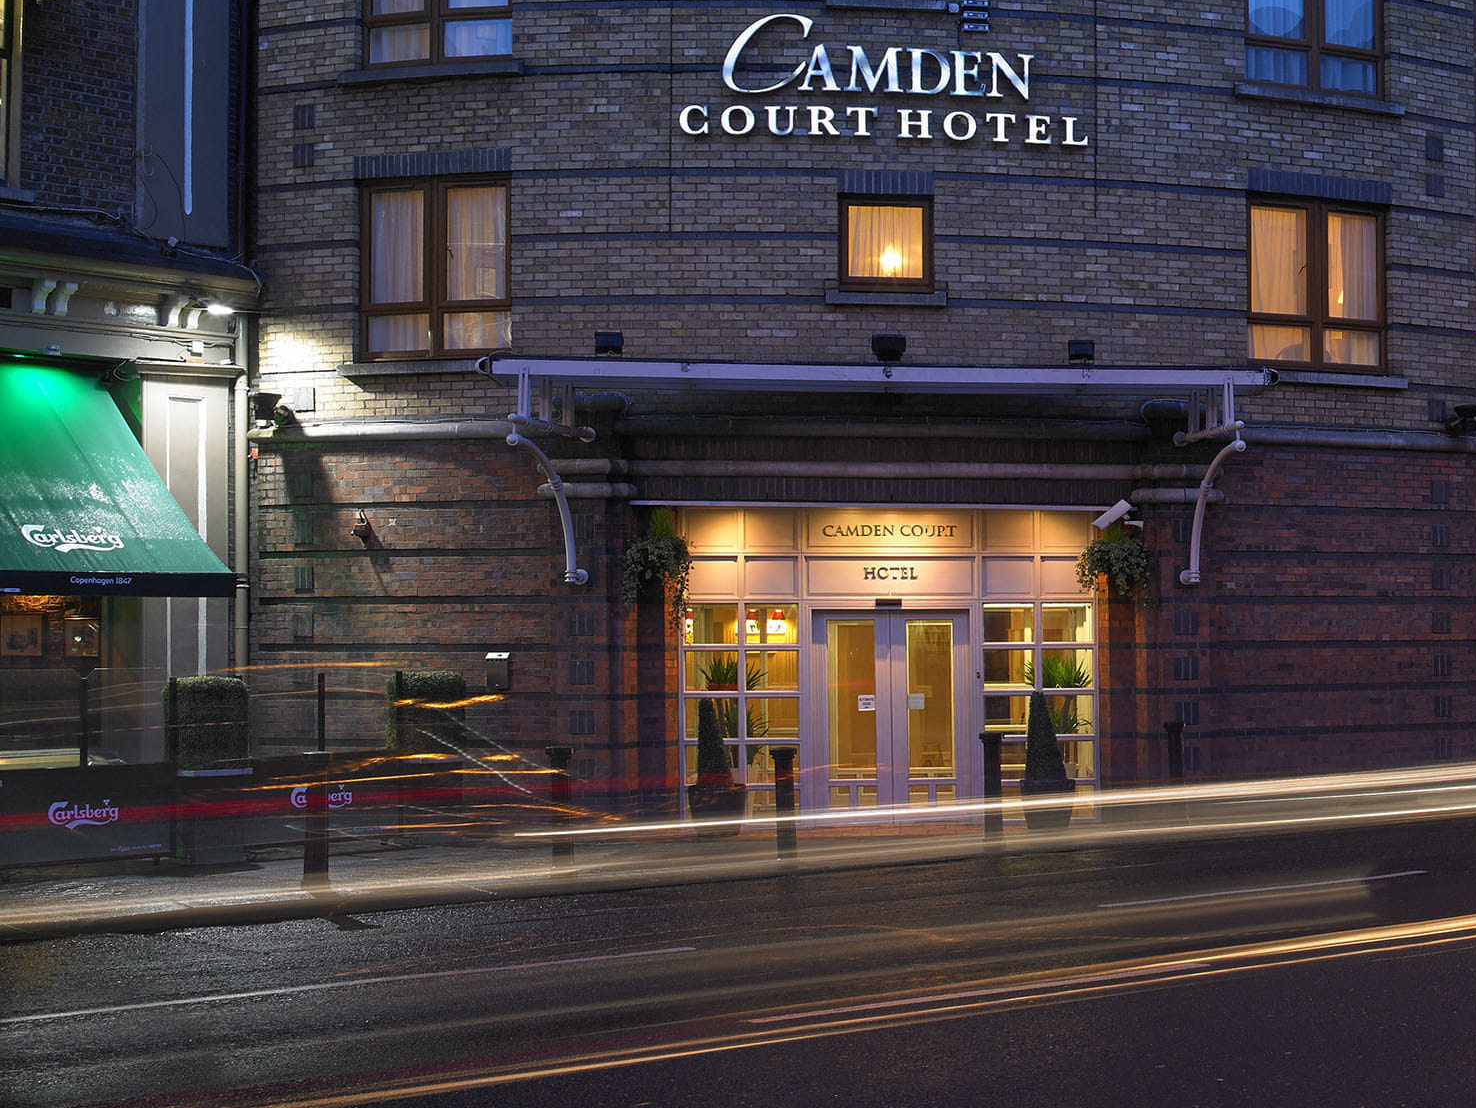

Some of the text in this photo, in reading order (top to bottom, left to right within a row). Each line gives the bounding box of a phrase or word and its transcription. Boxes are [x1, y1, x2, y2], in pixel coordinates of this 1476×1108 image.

[722, 13, 1035, 100] CAMDEN
[679, 105, 1089, 146] COURT HOTEL
[21, 524, 125, 553] Carlsberg
[822, 524, 957, 537] CAMDEN COURT
[70, 575, 114, 586] Copenhagen
[863, 567, 918, 580] HOTEL
[290, 784, 352, 808] Caerg
[48, 798, 119, 830] Carlsberg
